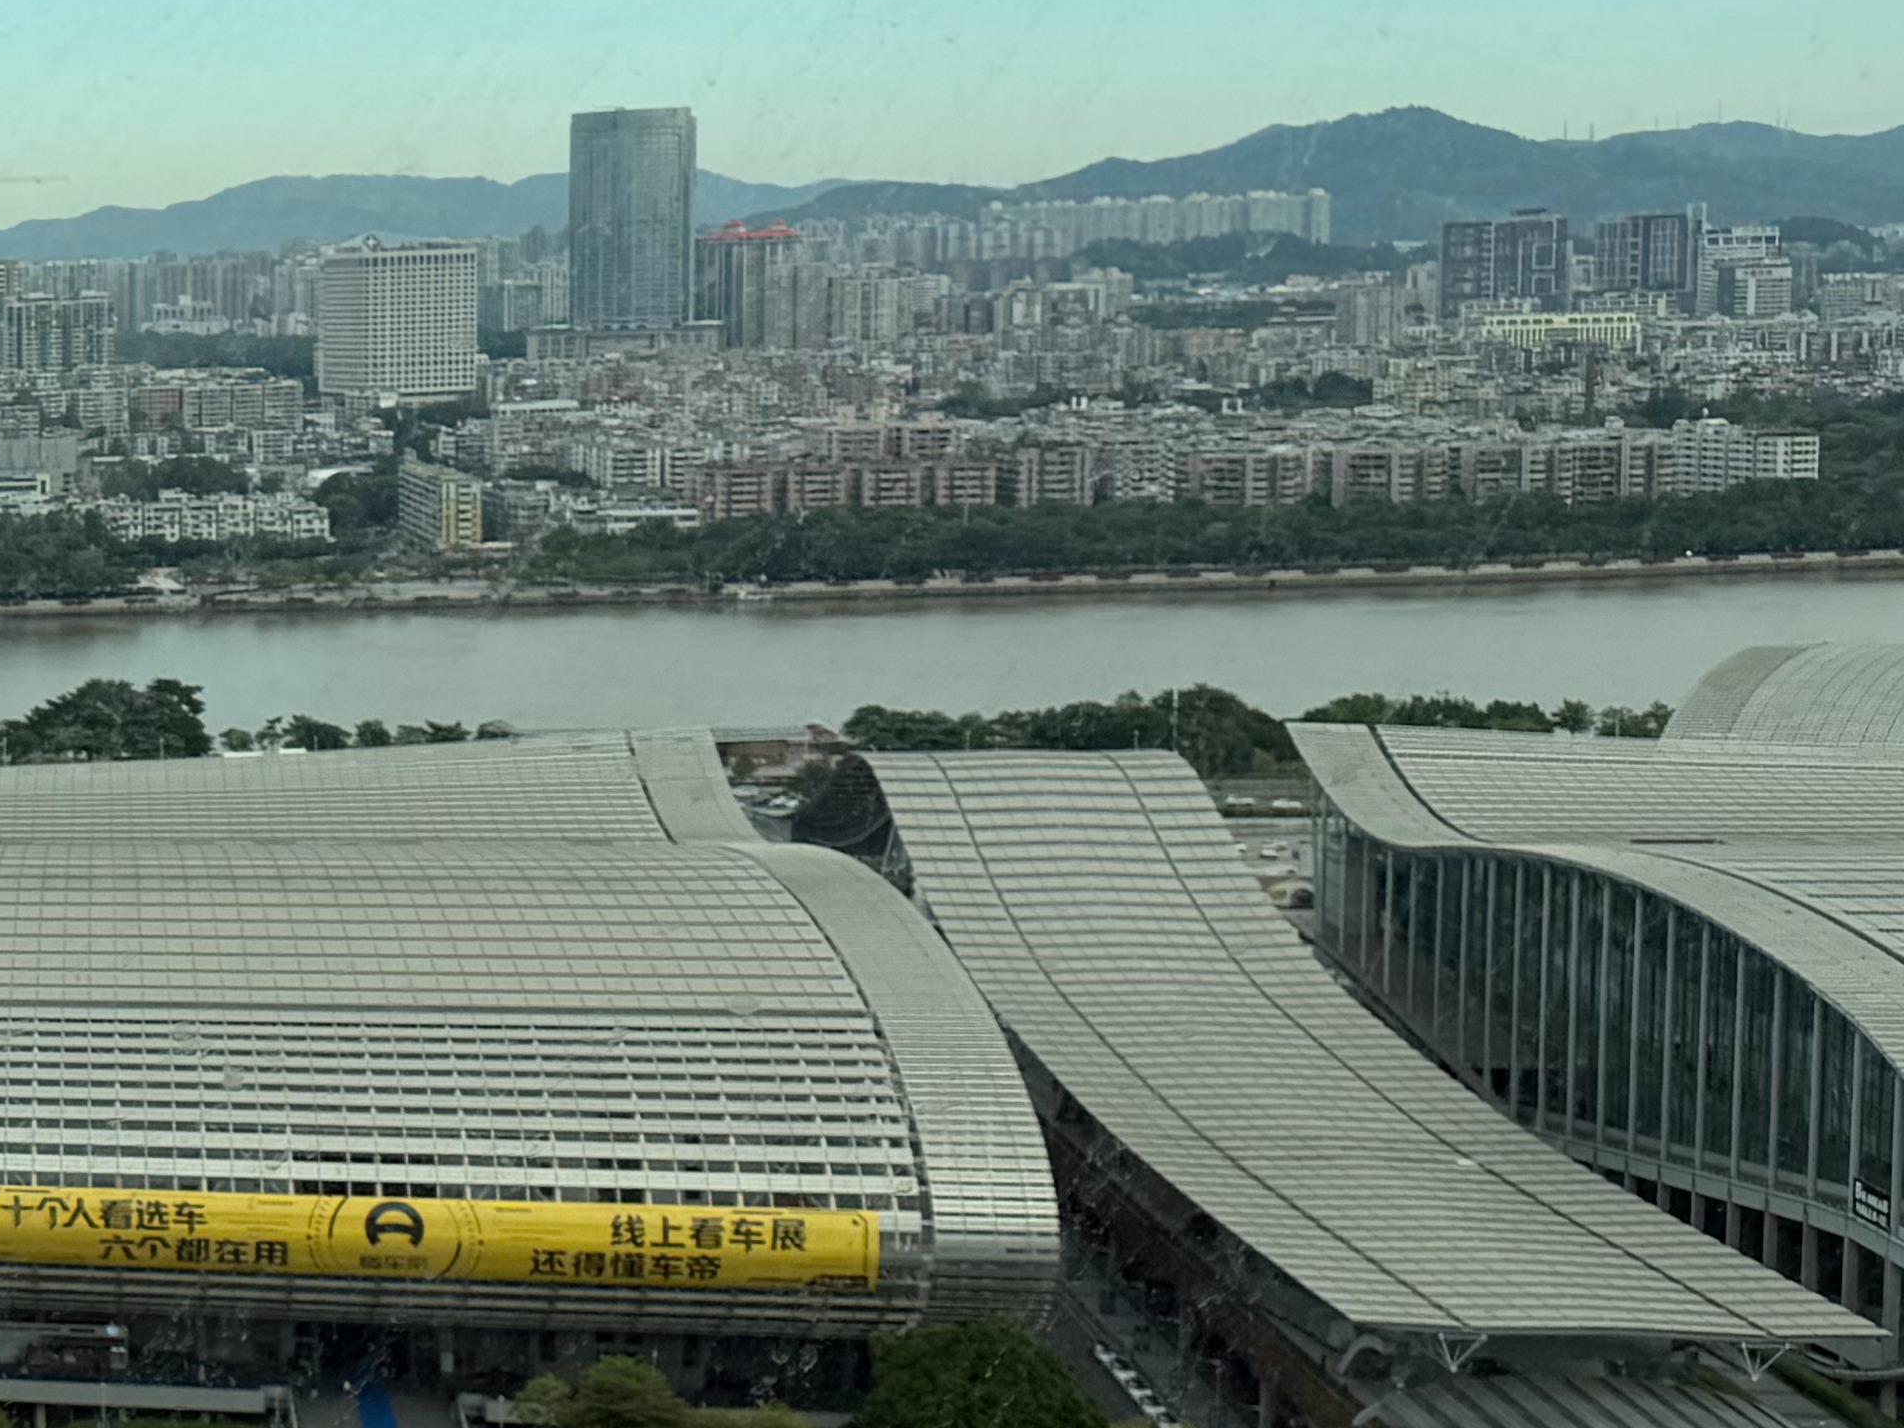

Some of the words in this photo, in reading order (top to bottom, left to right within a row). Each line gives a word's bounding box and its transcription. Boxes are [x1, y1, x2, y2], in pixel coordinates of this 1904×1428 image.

[0, 1195, 208, 1234] 十个人看选车
[100, 1235, 289, 1266] 六个都在用
[610, 1214, 807, 1253] 线上看车展
[530, 1249, 722, 1280] 还得懂车帝
